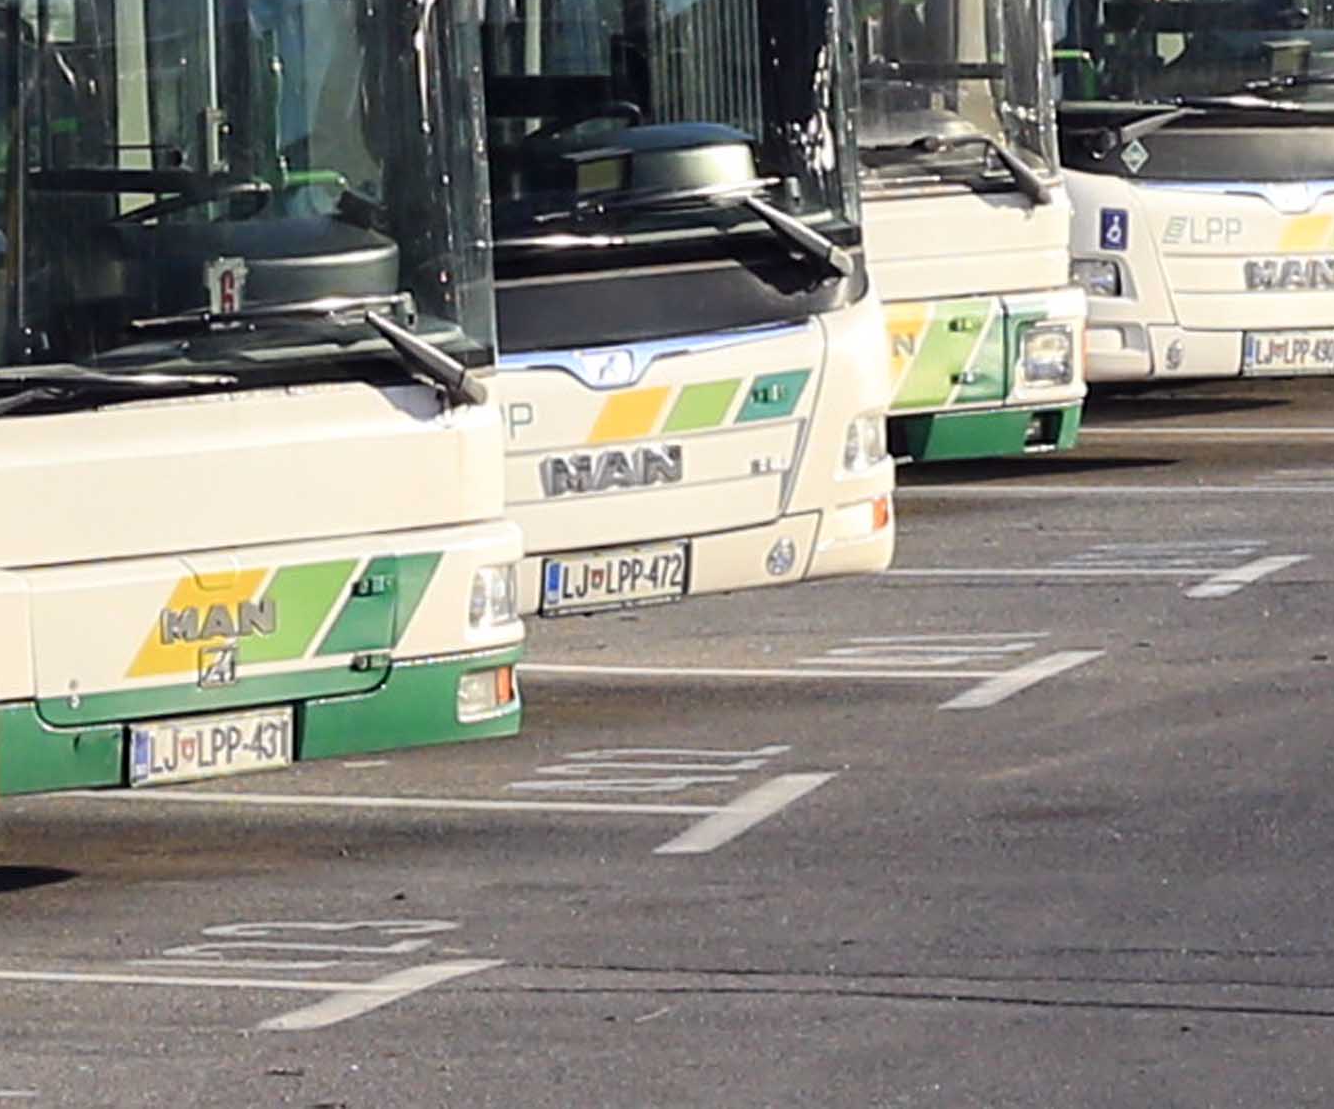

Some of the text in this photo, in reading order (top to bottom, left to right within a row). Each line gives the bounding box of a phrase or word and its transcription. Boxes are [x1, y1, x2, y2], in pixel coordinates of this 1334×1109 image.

[1189, 217, 1242, 244] LPP
[539, 444, 683, 497] MAN
[562, 553, 683, 600] LJ LPP-472
[159, 601, 278, 645] MAN
[149, 719, 289, 773] LJ LPP-431
